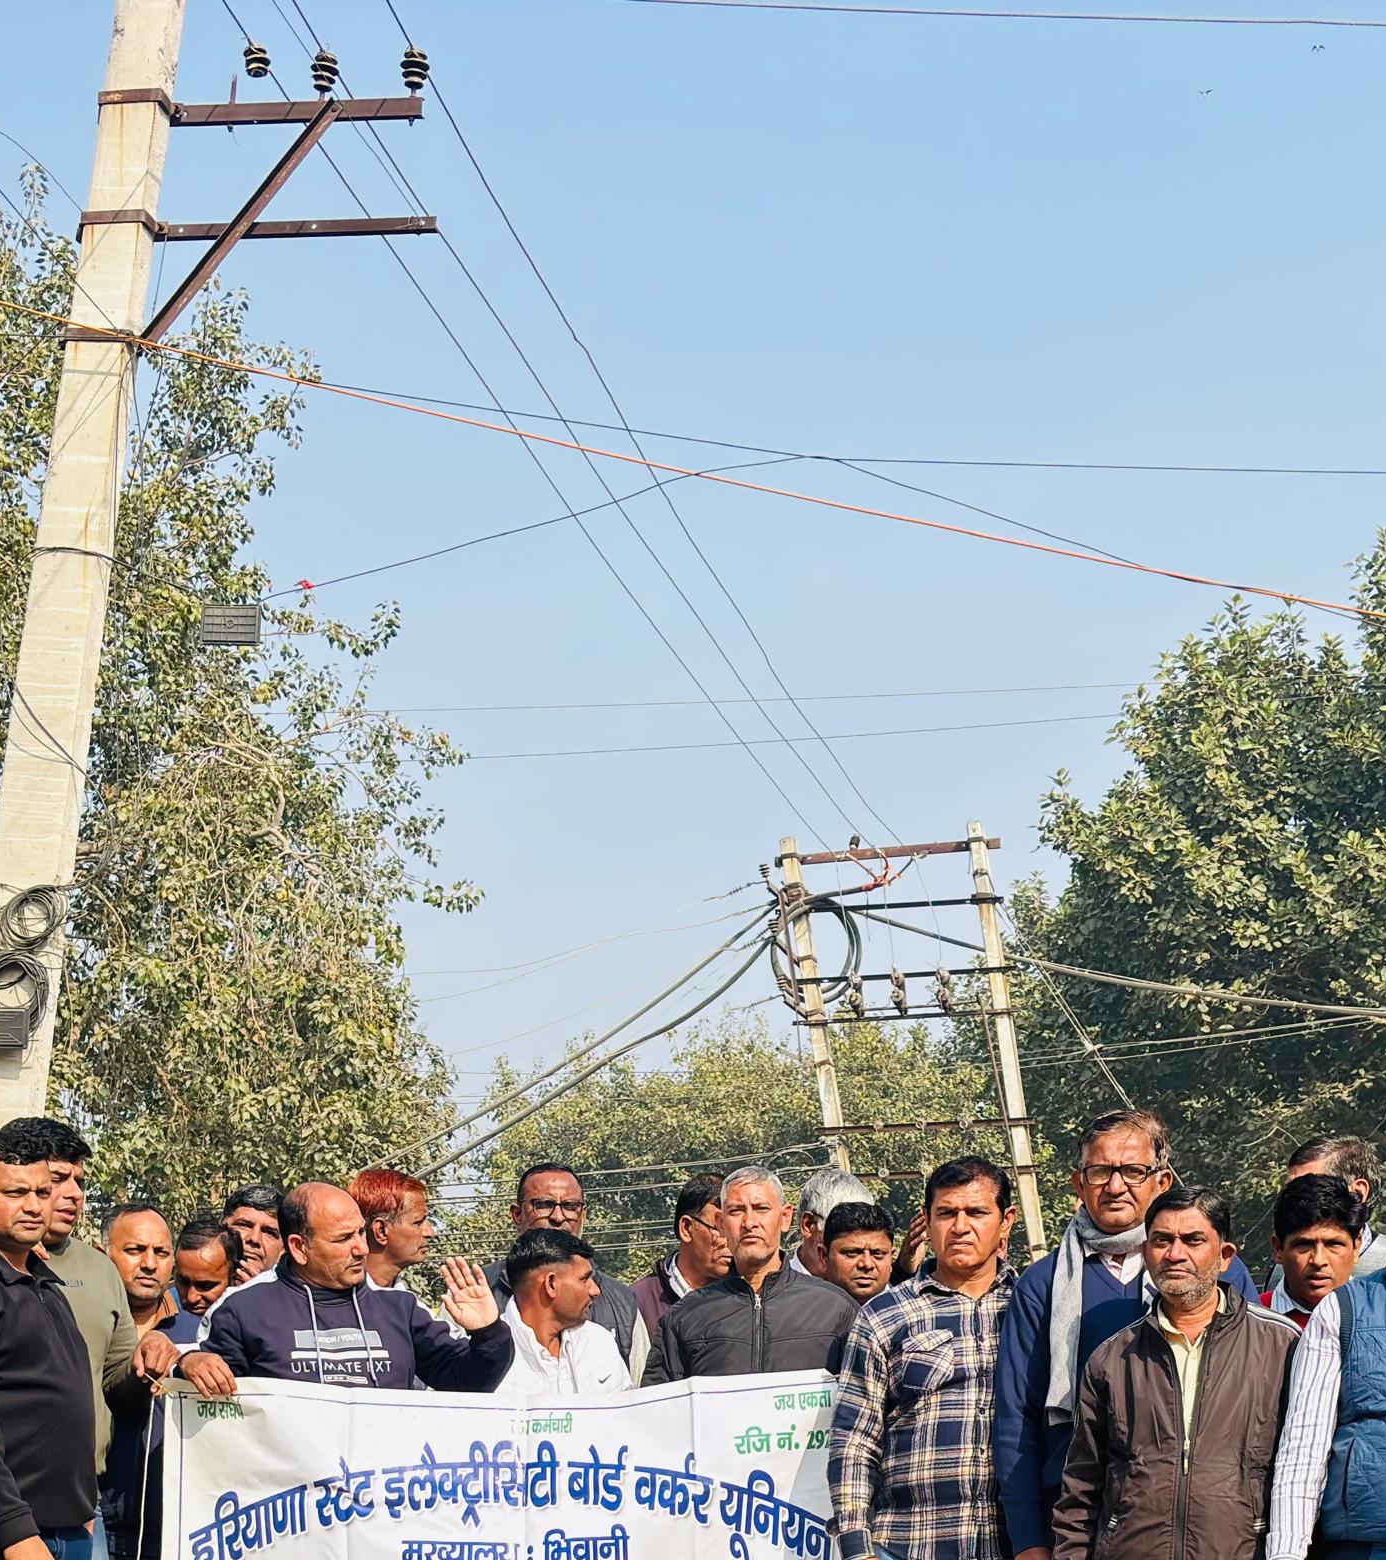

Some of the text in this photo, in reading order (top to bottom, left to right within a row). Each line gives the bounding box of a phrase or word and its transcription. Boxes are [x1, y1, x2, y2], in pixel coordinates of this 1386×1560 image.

[291, 1361, 362, 1374] ULTMATE
[197, 1400, 217, 1419] जय
[773, 1389, 832, 1411] जय एकता
[532, 1411, 573, 1434] कर्मचारी
[734, 1425, 771, 1455] रजि
[567, 1444, 628, 1512] बोर्ड
[634, 1452, 714, 1524] वर्कर
